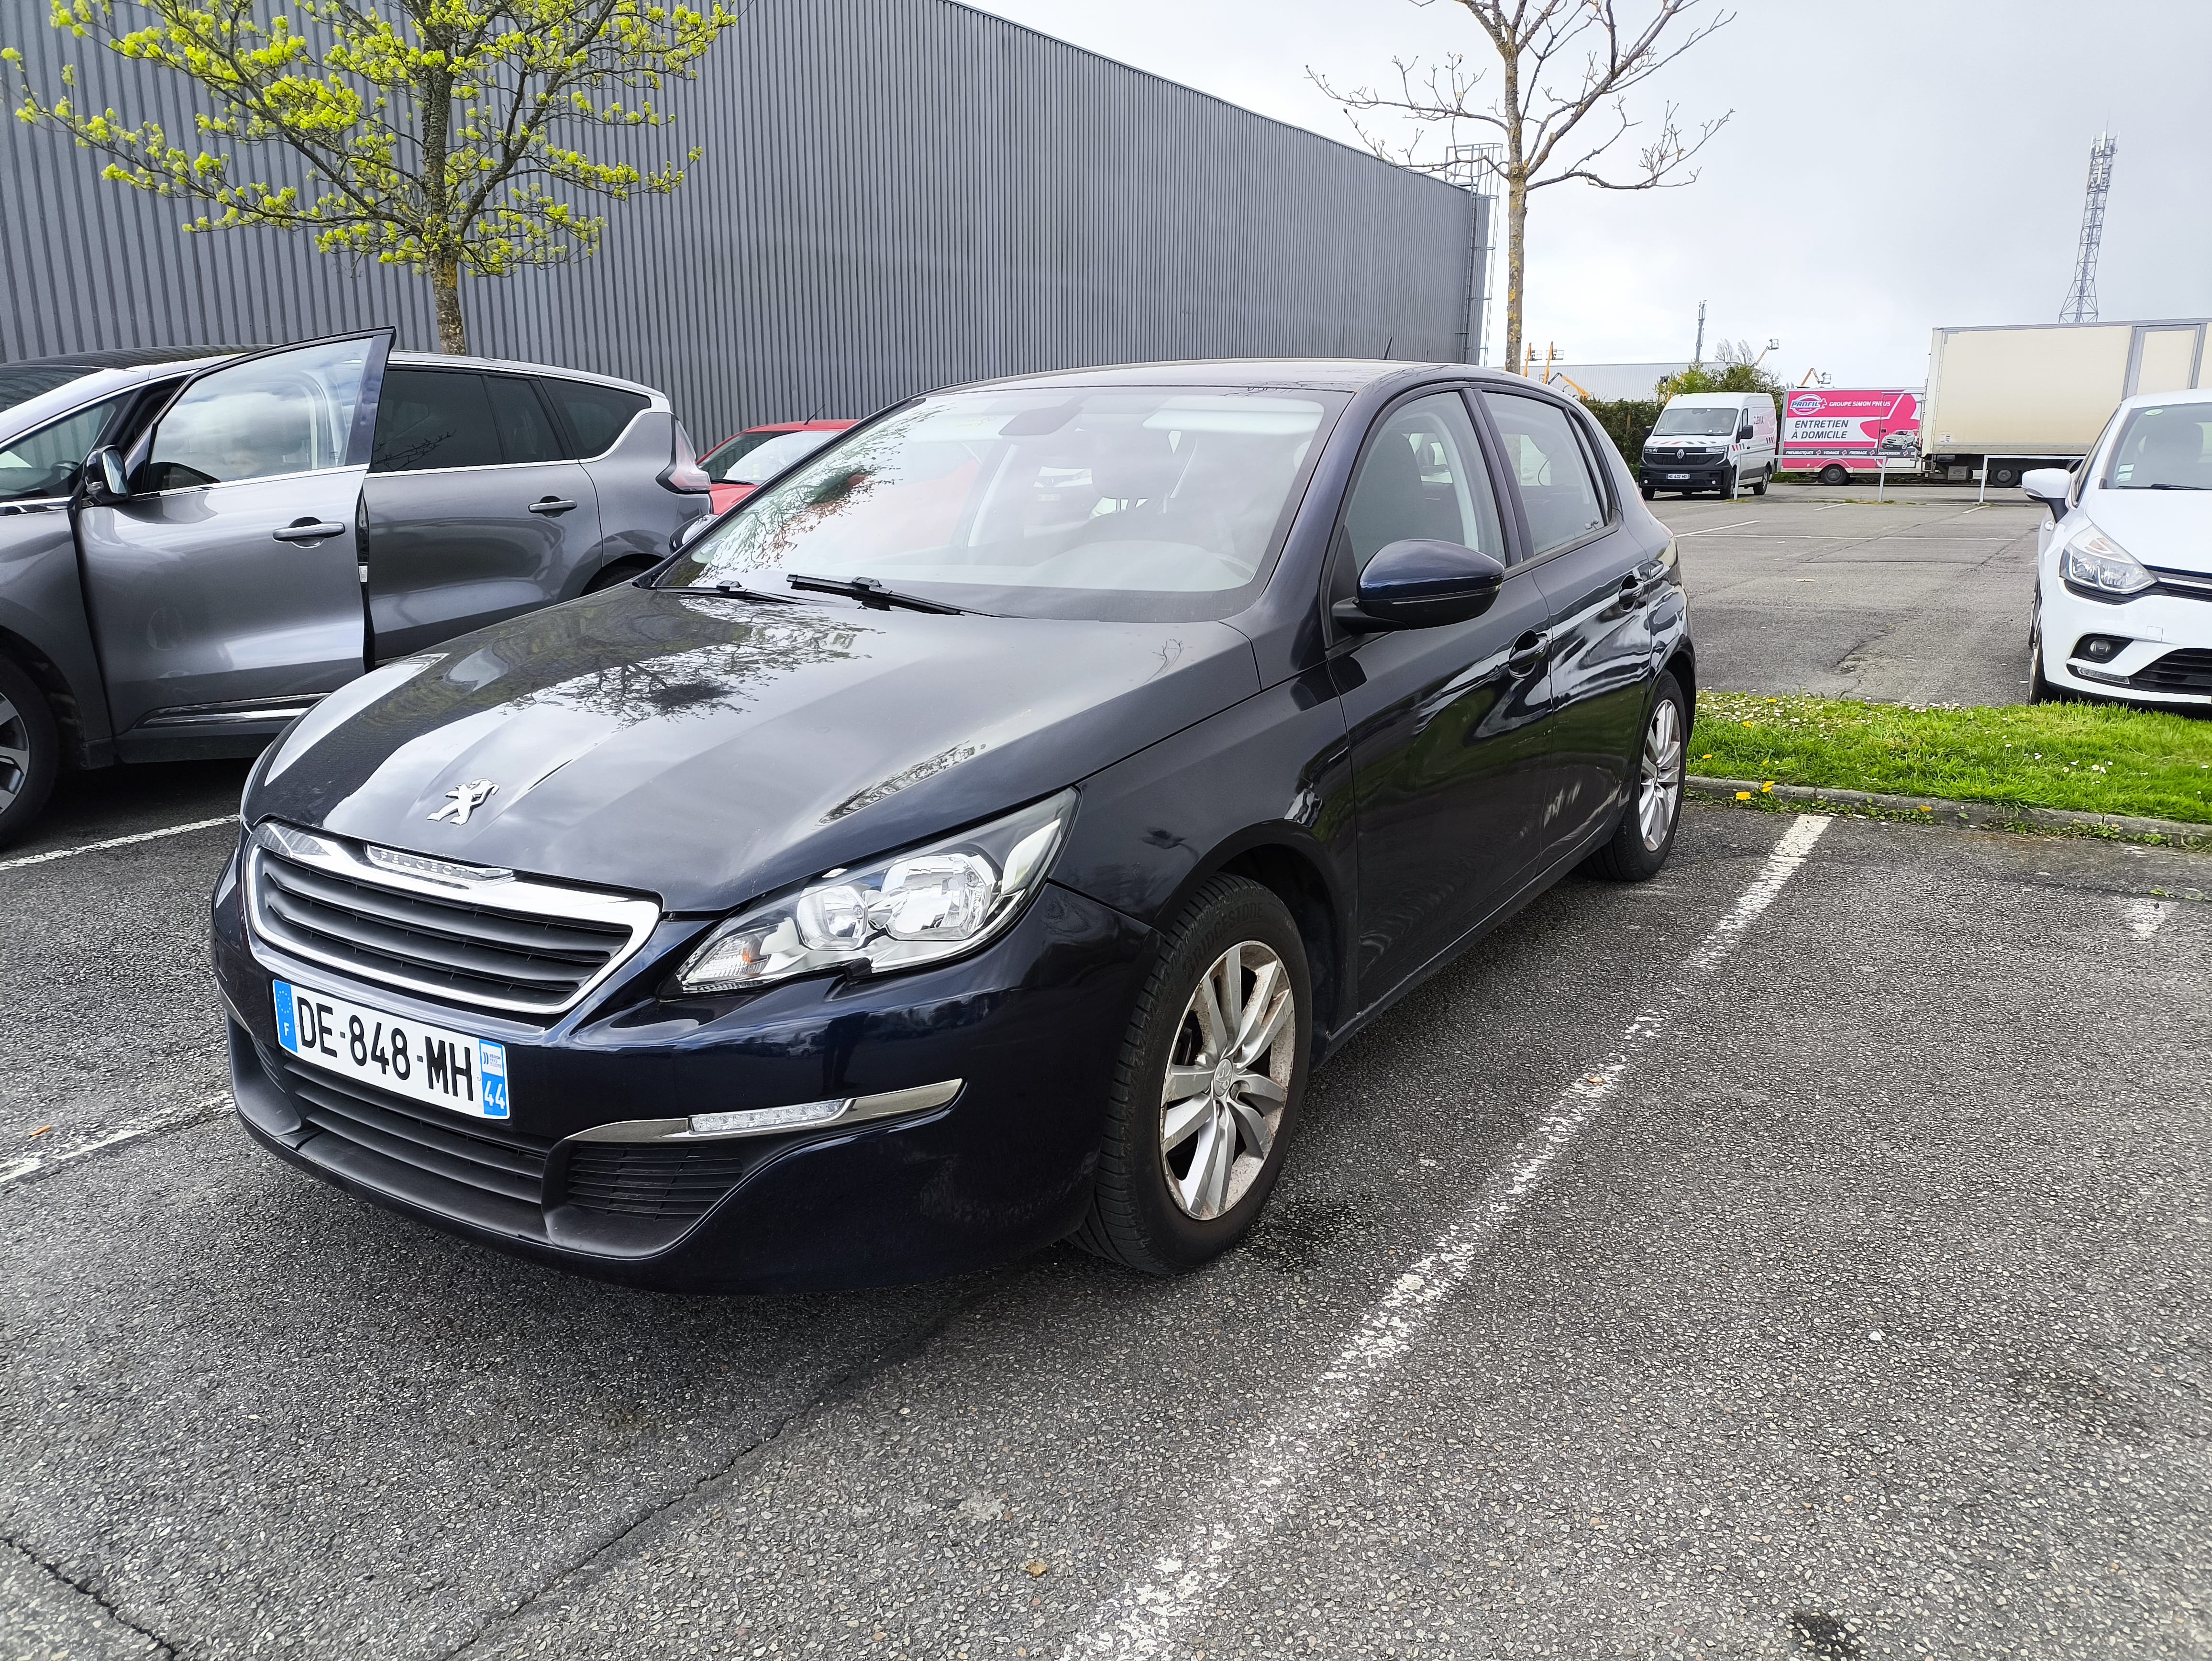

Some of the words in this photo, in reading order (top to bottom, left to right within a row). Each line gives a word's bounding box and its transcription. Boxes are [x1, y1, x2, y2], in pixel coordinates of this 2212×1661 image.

[1791, 429, 1798, 439] À
[1795, 420, 1848, 428] ENTRETIEN
[380, 852, 466, 877] PEUGEOT
[284, 1022, 289, 1037] F
[297, 996, 474, 1102] DE-848-MH
[485, 1080, 505, 1109] 44
